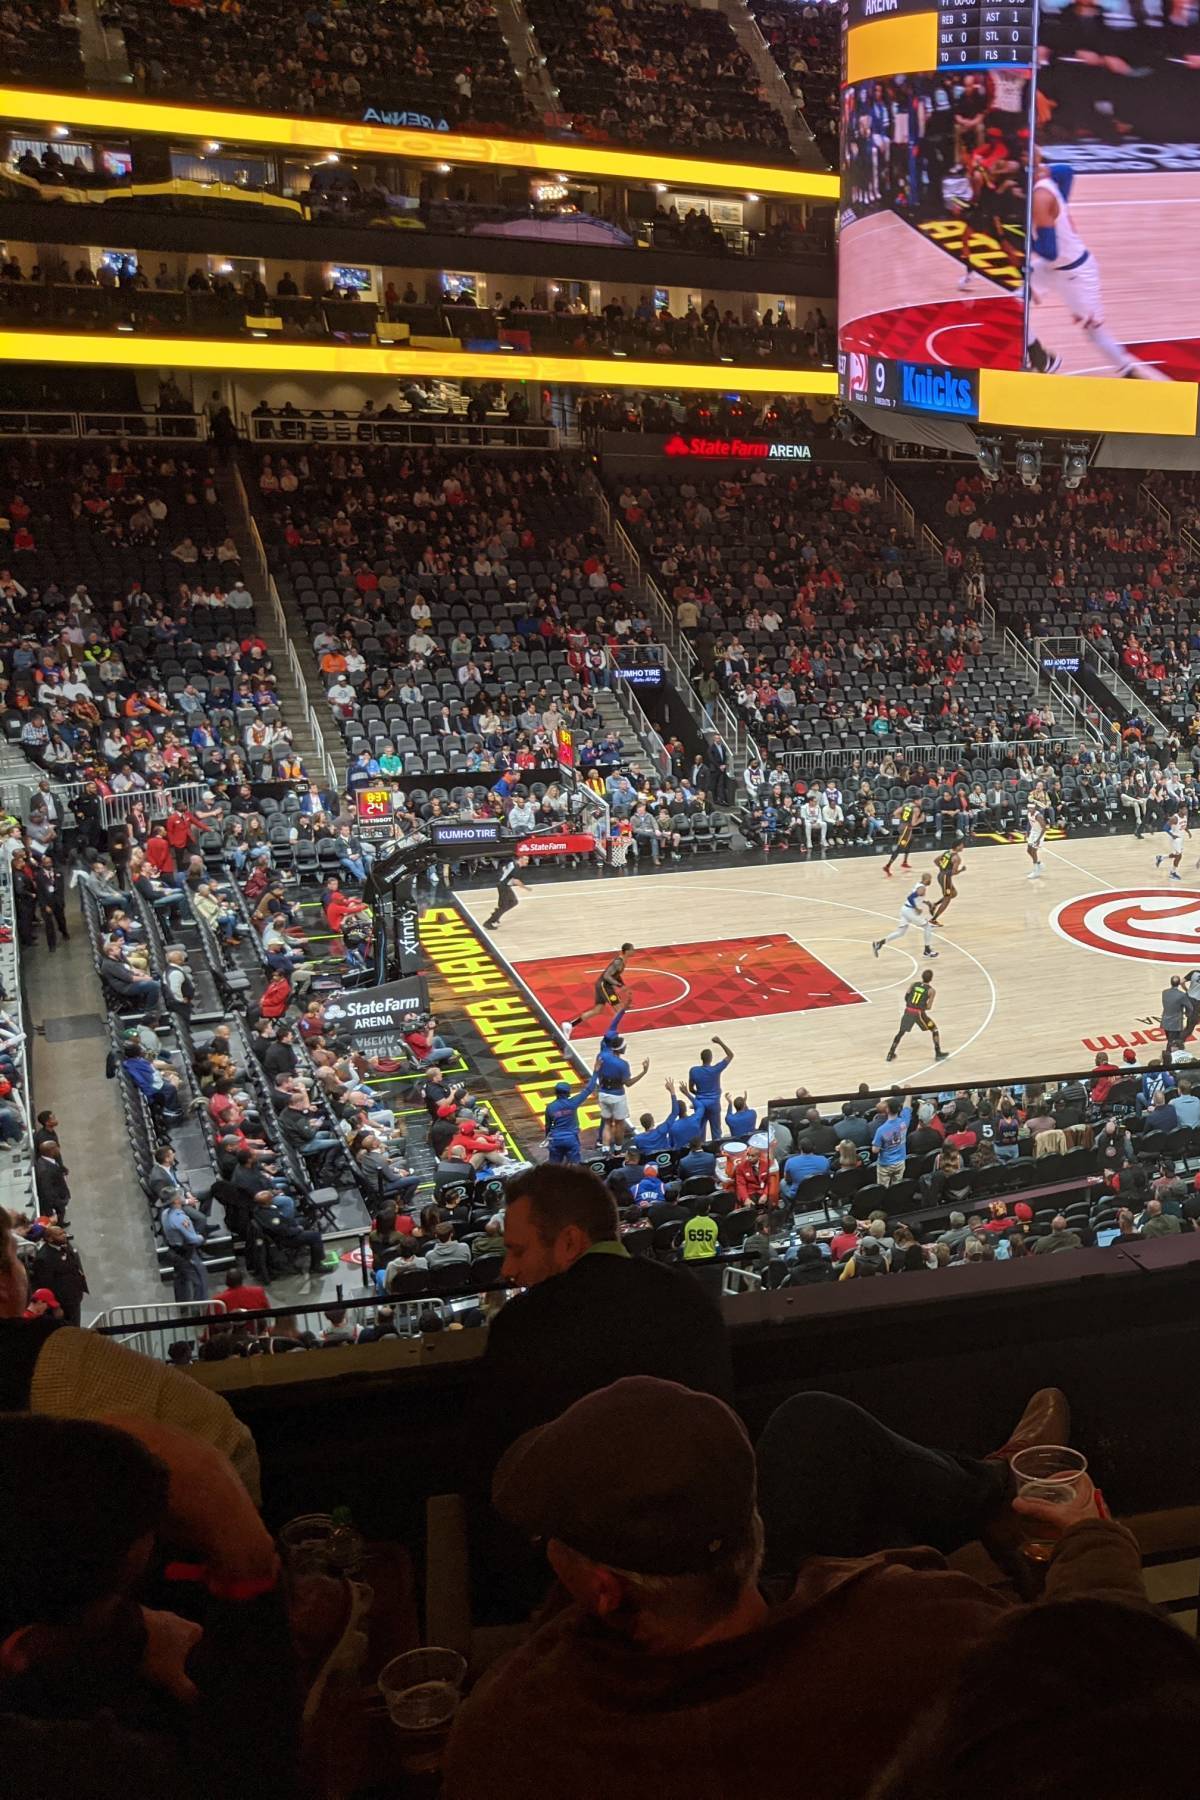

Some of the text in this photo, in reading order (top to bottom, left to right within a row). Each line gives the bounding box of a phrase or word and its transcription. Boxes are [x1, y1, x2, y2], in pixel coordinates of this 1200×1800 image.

[941, 11, 1018, 24] REB 3 AST 1
[941, 31, 1018, 43] BLK 0 STL 0
[941, 50, 1017, 62] TO 0 FLS 1
[875, 362, 885, 393] 9
[903, 366, 971, 410] Knicks
[769, 444, 812, 458] ARENA
[367, 803, 383, 814] 24
[439, 829, 496, 840] KUMHO TIRE
[400, 908, 419, 955] xfinity
[418, 906, 511, 993] HAWKS
[911, 991, 921, 1004] 11
[354, 1015, 394, 1030] ARENA
[982, 1124, 994, 1138] 5
[688, 1228, 714, 1242] 695
